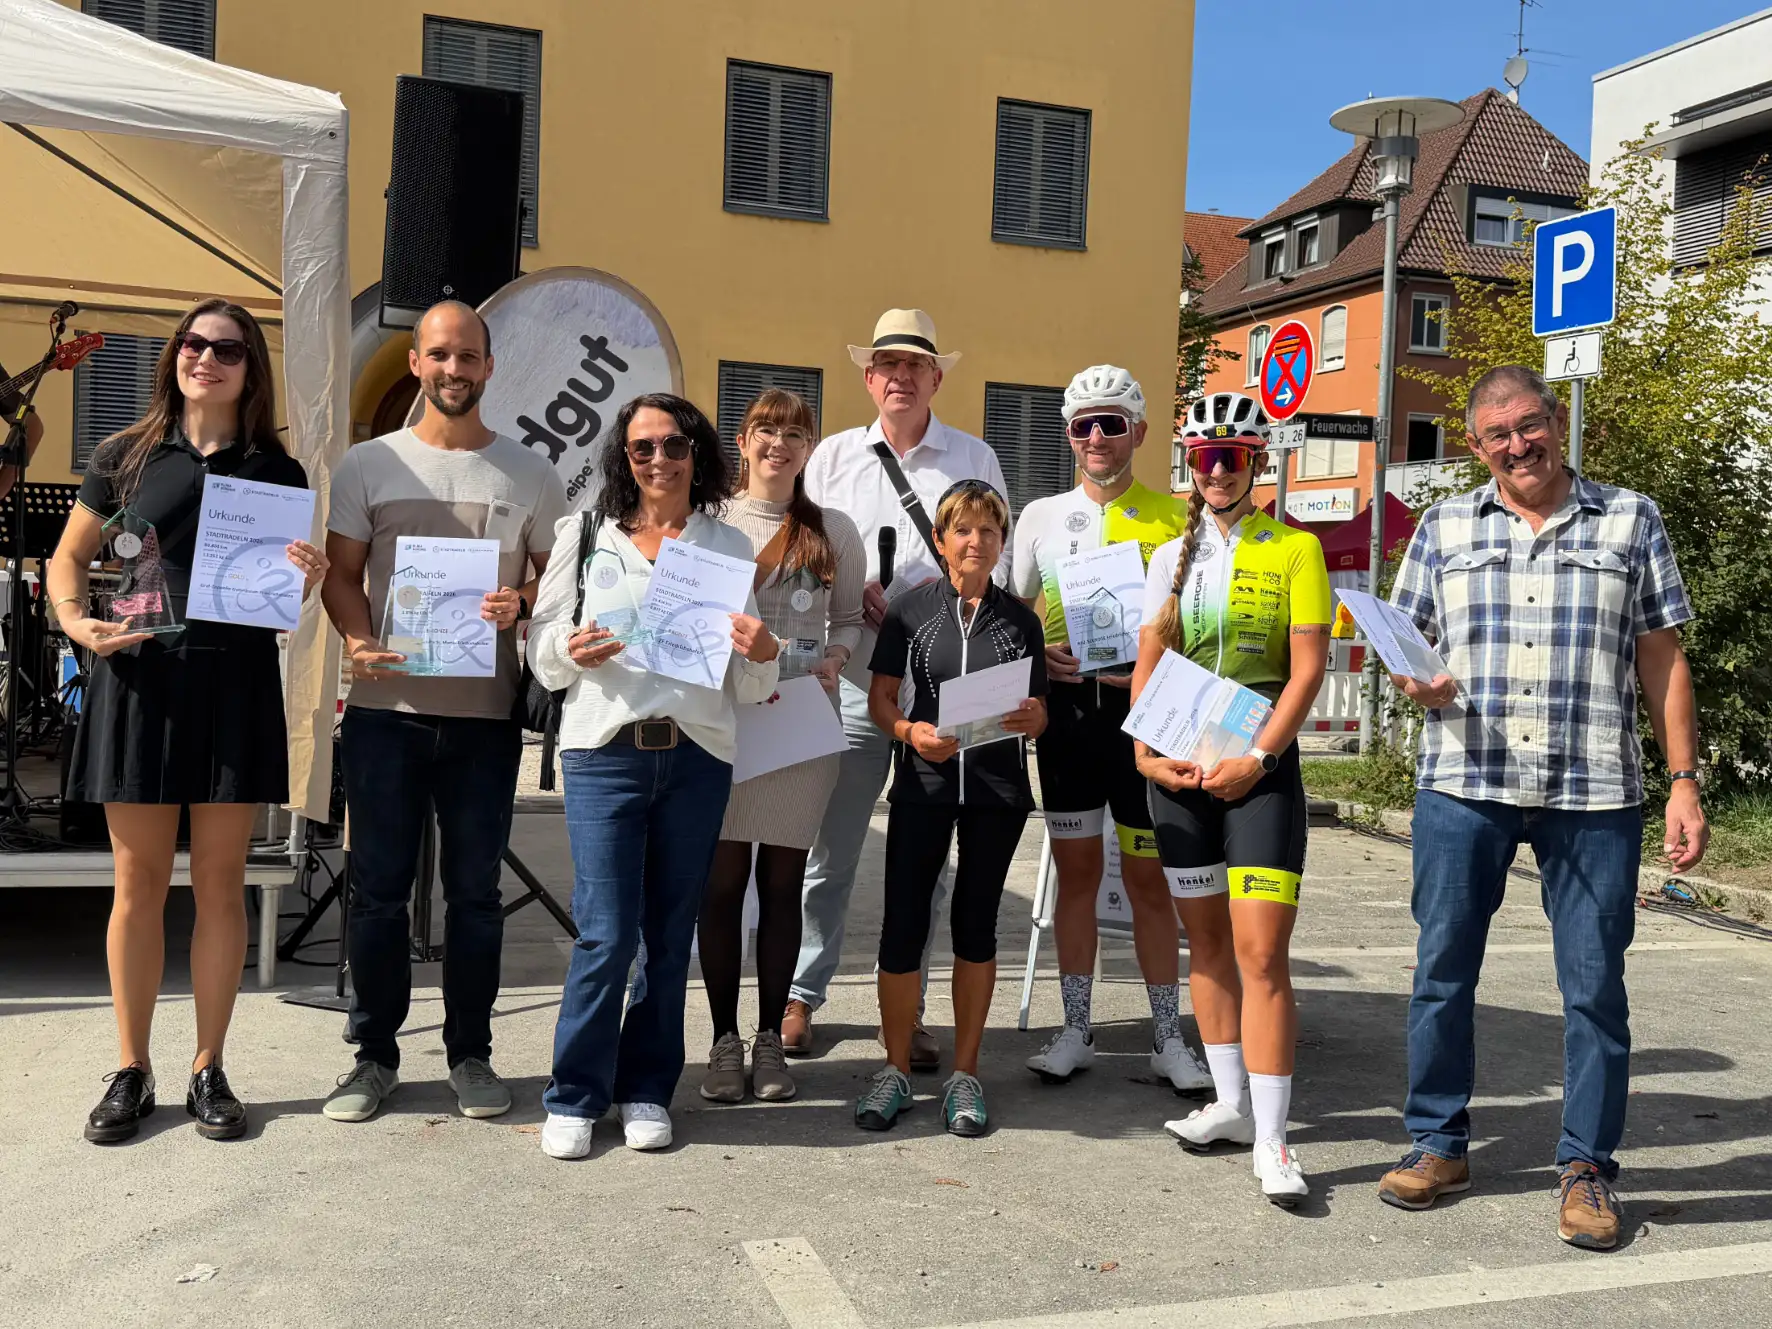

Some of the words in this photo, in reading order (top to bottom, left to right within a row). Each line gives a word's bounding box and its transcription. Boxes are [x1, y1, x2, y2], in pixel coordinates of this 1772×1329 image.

[1552, 230, 1595, 318] P
[1215, 425, 1227, 437] 69
[1311, 417, 1369, 435] Feuerwache
[208, 508, 256, 525] Urkunde
[403, 569, 447, 580] Urkunde
[660, 567, 701, 588] Urkunde
[1065, 575, 1102, 590] Urkunde
[1193, 569, 1204, 625] SEEROSE
[1152, 707, 1179, 743] Urkunde
